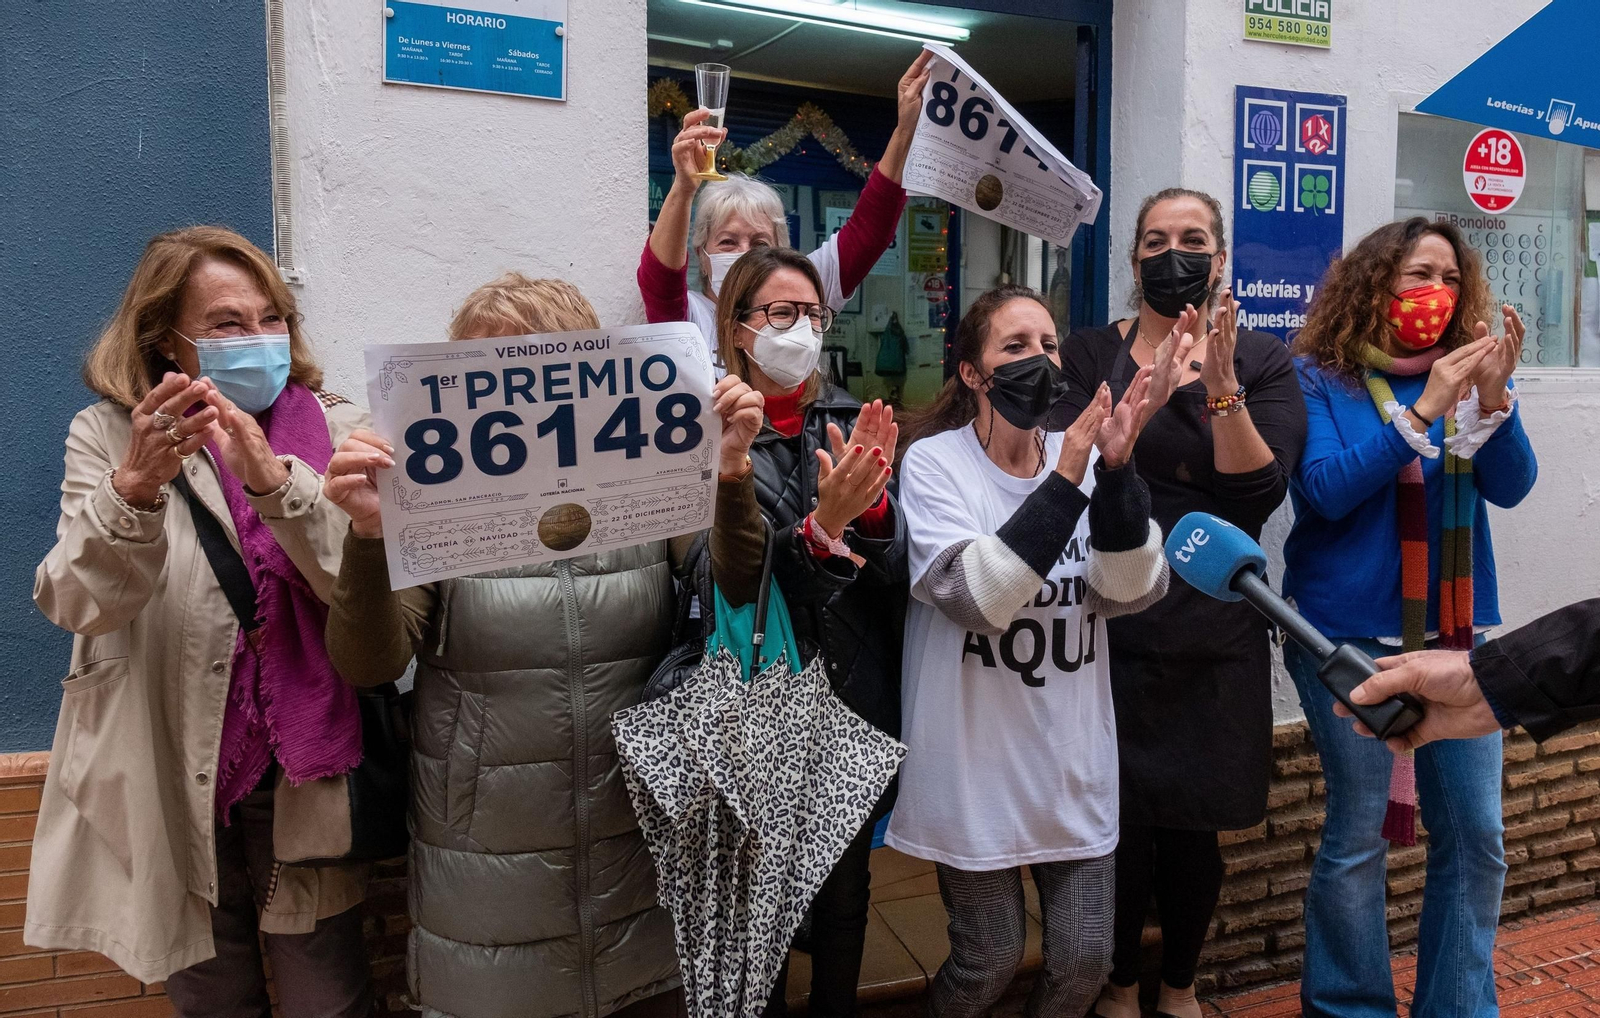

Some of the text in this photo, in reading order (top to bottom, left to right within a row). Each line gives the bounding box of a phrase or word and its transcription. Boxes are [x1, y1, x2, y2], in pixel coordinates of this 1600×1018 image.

[446, 12, 506, 30] HORARIO
[1249, 17, 1328, 37] 954 580 949
[411, 38, 433, 46] Lunes
[442, 41, 471, 51] Viernes
[1248, 31, 1328, 44] www.hercules-seguridad.com
[508, 49, 539, 59] Sábados
[1487, 97, 1534, 116] Loterías
[1536, 110, 1544, 120] y
[1478, 138, 1512, 165] +18
[915, 162, 937, 172] LOTERÍA
[1450, 215, 1506, 230] Bonoloto
[1237, 278, 1315, 303] Loterías y
[1236, 309, 1308, 331] Apuestas
[495, 335, 610, 358] VENDIDO AQUÍ
[420, 374, 458, 414] 1er
[465, 354, 677, 410] PREMIO
[404, 393, 703, 485] 86148
[636, 506, 675, 518] DICIEMBRE
[421, 540, 458, 550] LOTERÍA
[479, 532, 518, 542] NAVIDAD
[1175, 528, 1210, 563] tve
